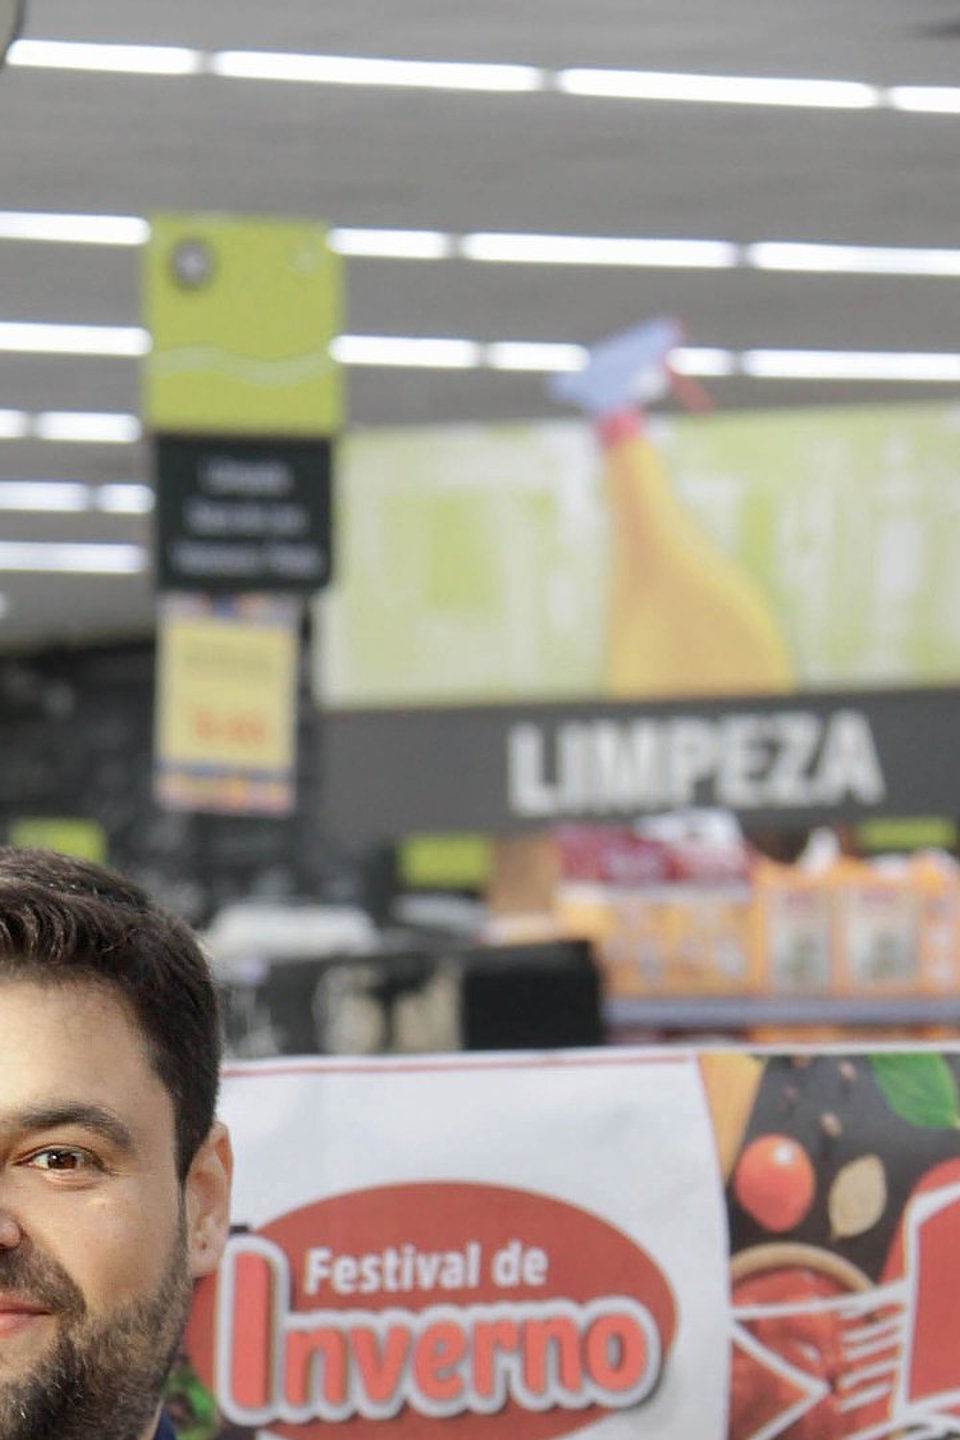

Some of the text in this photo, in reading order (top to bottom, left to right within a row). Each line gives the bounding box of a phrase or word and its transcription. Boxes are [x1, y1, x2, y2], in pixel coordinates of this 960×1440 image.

[508, 709, 886, 816] LIMPEZA
[303, 1239, 549, 1296] Festival de
[224, 1244, 654, 1414] Inverno
